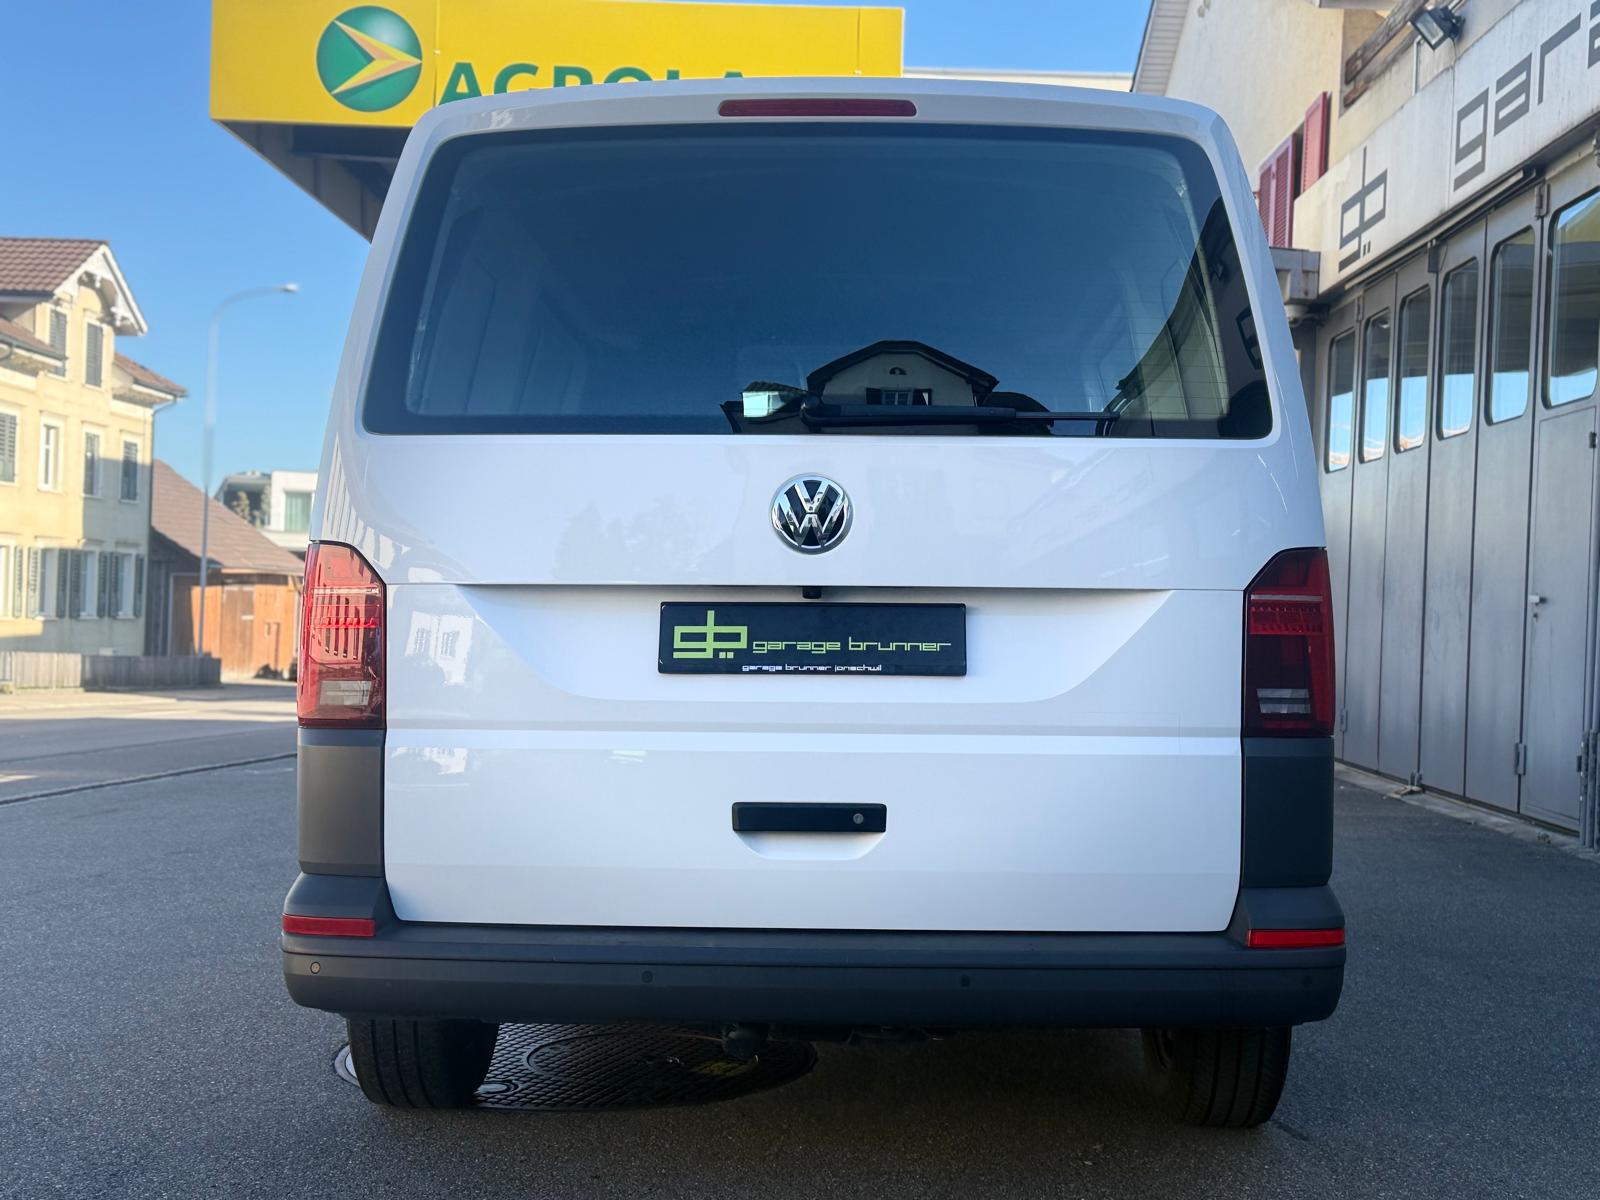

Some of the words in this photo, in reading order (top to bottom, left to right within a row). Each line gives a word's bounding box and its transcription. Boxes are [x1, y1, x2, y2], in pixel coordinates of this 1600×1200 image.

[438, 61, 745, 107] AGR
[1453, 0, 1600, 192] gar
[773, 474, 850, 551] VW
[742, 664, 783, 672] garage
[785, 663, 832, 671] brunner
[752, 641, 841, 654] garage
[848, 636, 952, 652] brunner
